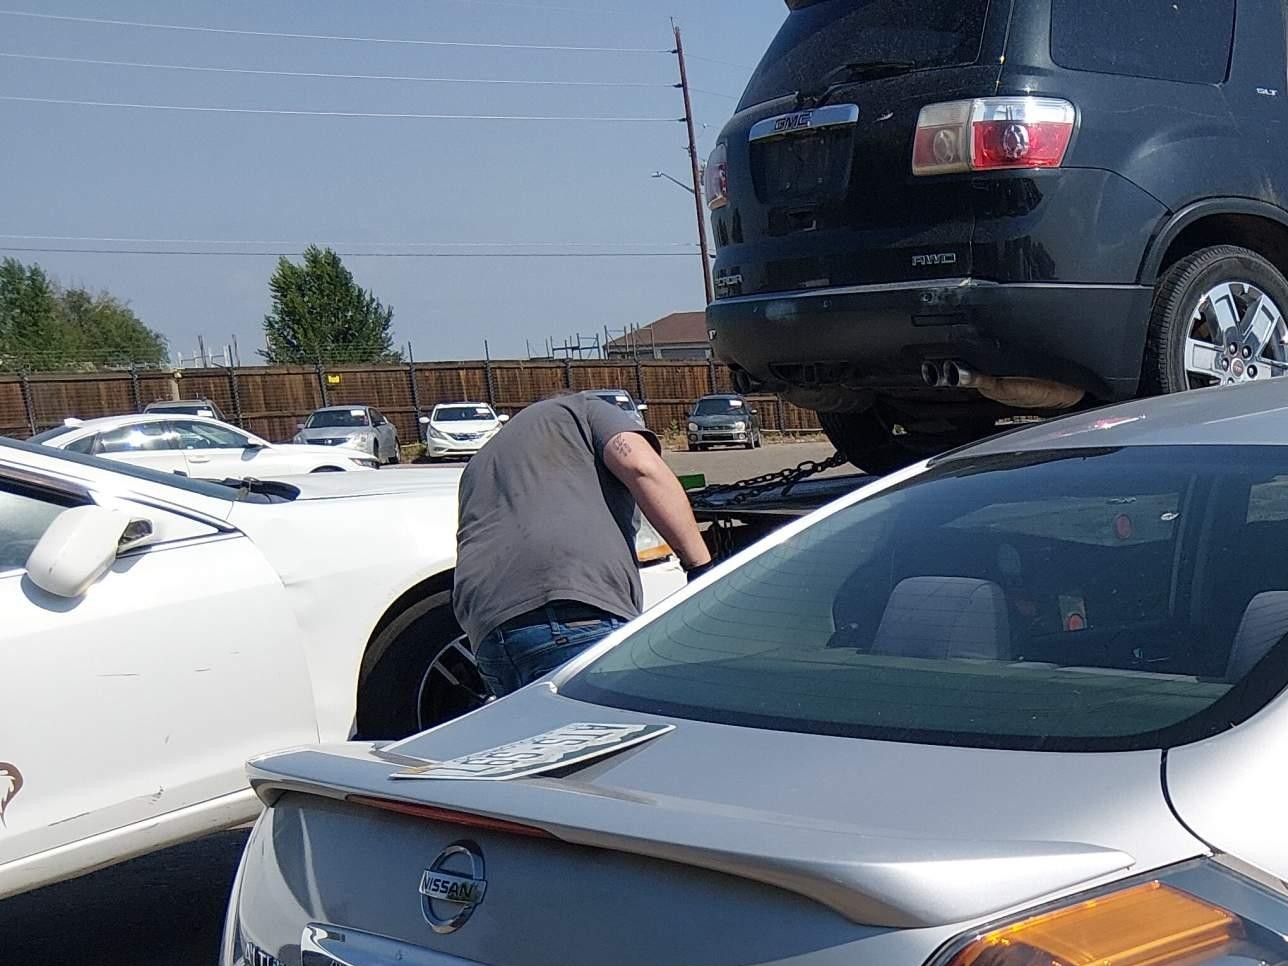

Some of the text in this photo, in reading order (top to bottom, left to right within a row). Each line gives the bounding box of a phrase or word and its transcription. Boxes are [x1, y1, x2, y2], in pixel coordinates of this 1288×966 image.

[774, 111, 811, 130] GMC
[911, 253, 956, 266] AWD
[421, 871, 473, 899] NISSAN
